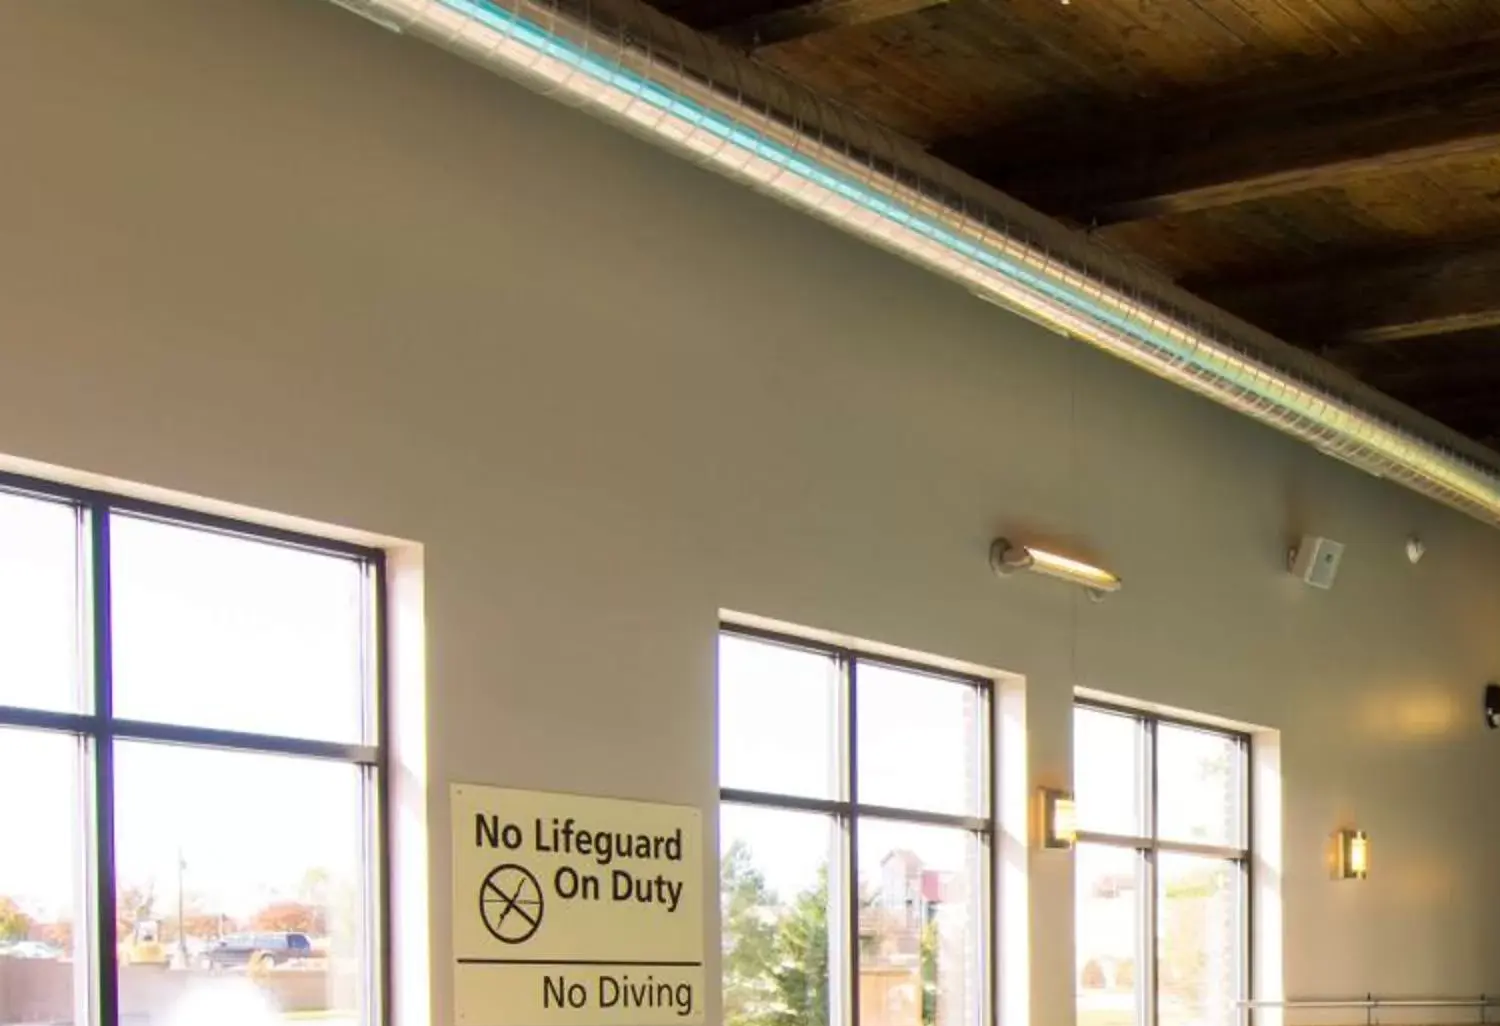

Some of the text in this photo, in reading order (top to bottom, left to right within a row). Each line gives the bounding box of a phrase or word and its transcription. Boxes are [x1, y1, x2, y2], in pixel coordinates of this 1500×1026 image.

[475, 813, 682, 865] No Lifeguard
[554, 866, 683, 913] On Duty
[543, 975, 692, 1016] No Diving
